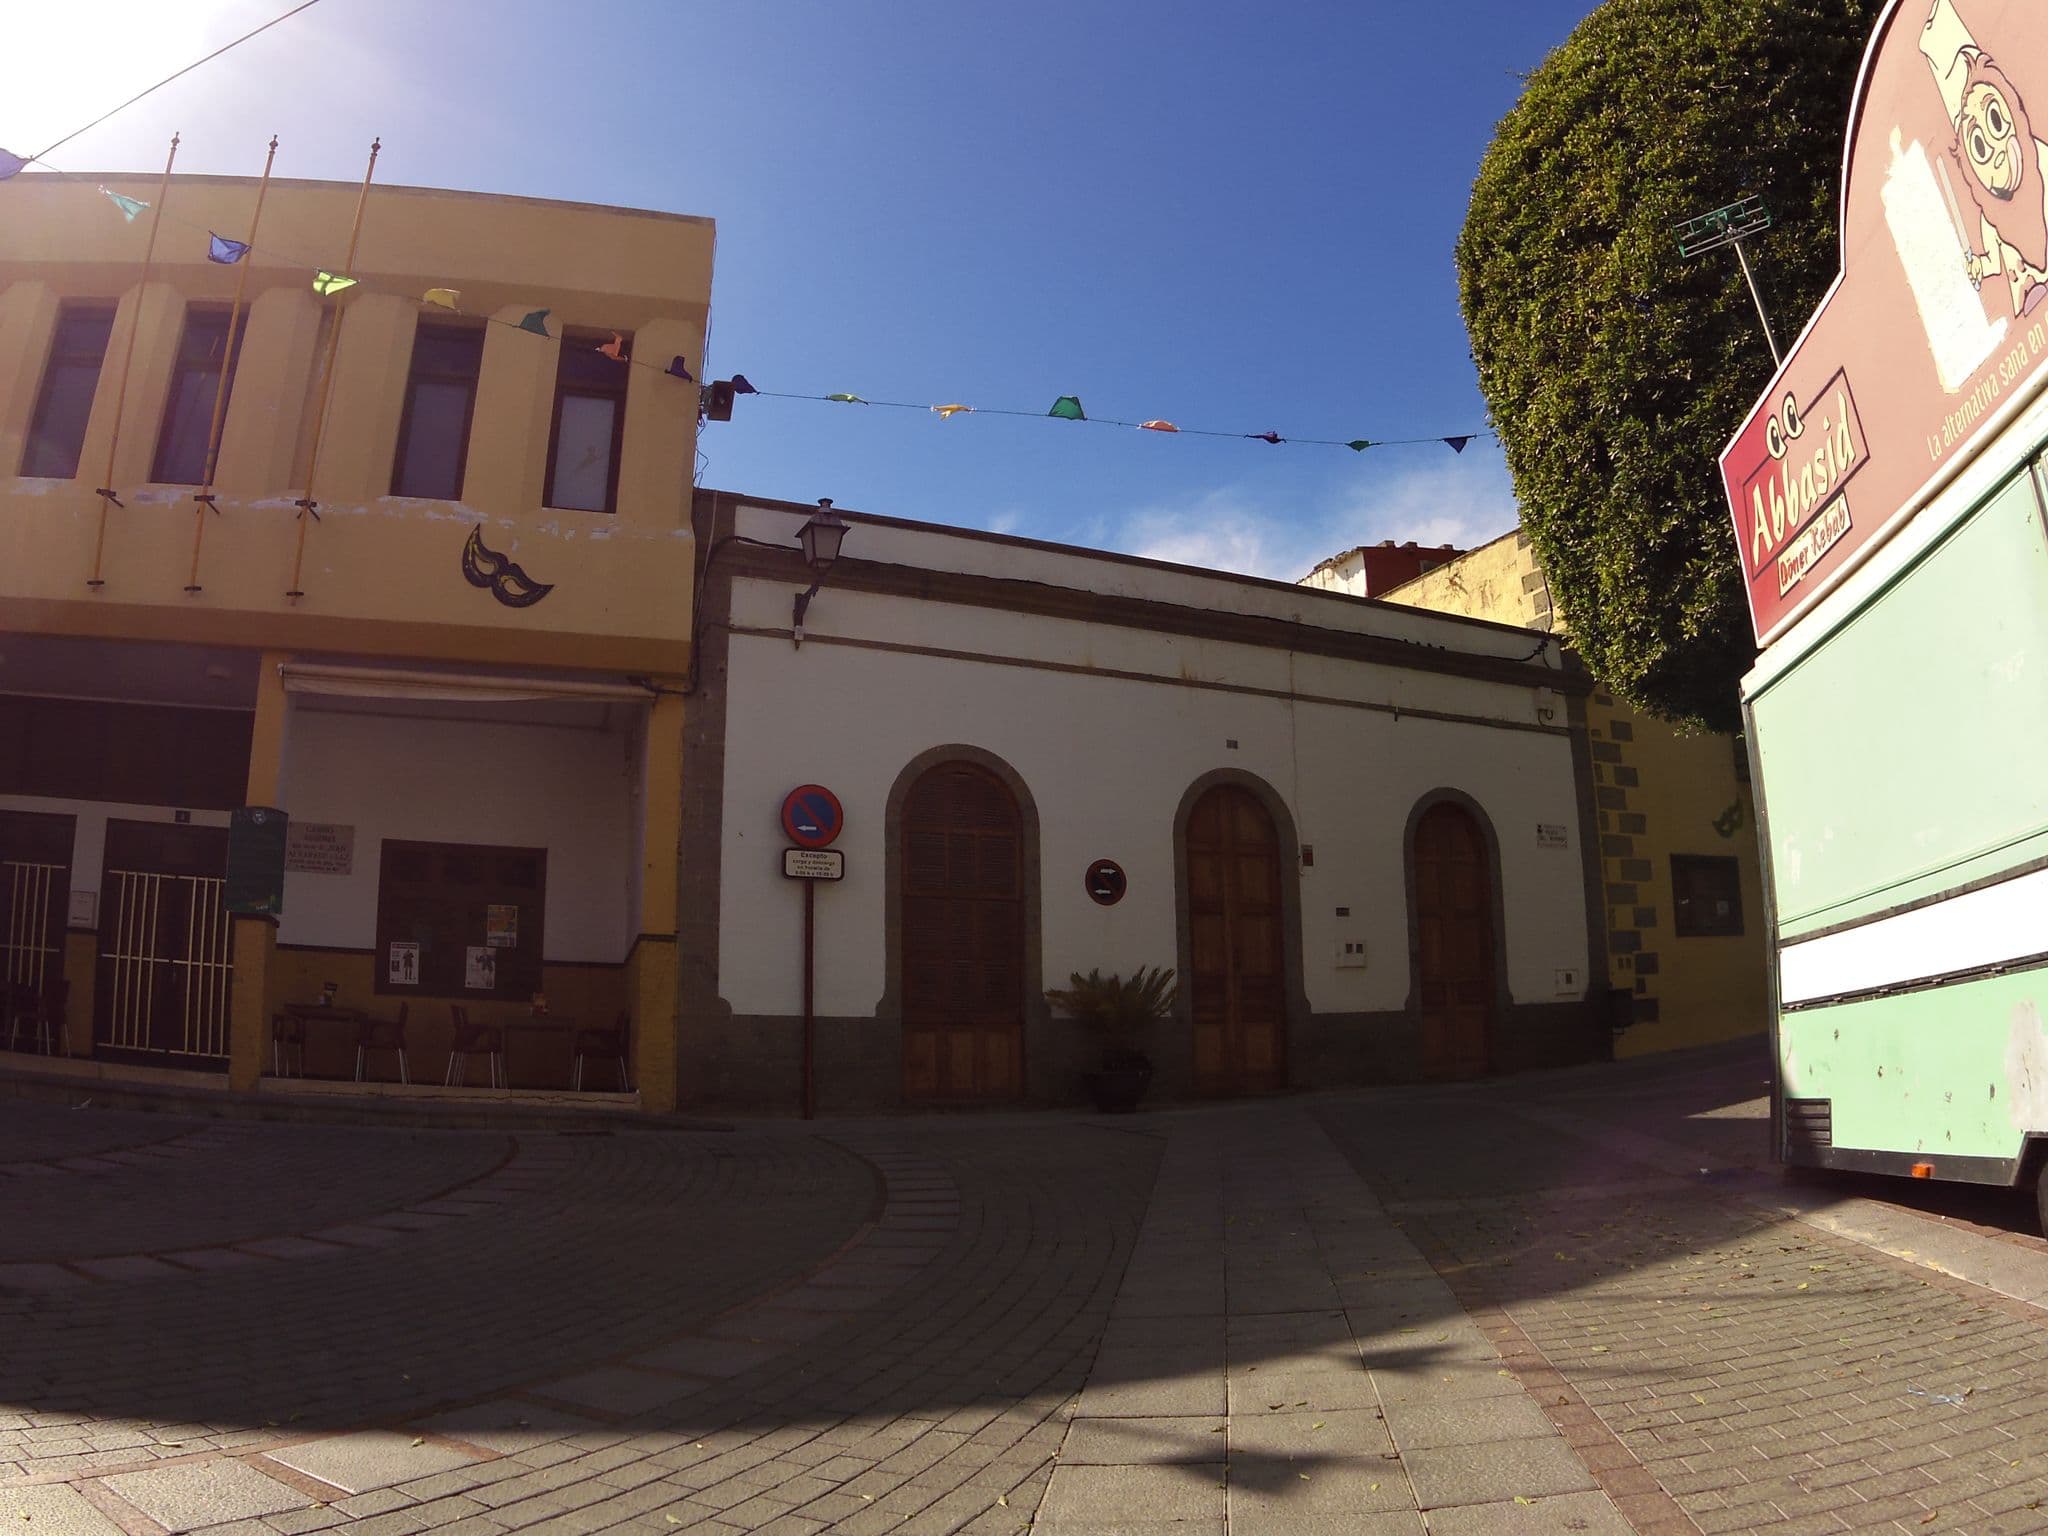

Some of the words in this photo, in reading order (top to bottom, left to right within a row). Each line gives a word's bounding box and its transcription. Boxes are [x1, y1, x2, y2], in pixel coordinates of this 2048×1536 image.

[1926, 434, 1942, 461] La
[1941, 373, 2000, 448] alternativa
[1999, 341, 2029, 387] sana
[2027, 322, 2047, 355] en
[1752, 390, 1856, 567] Abbasid
[1780, 546, 1809, 587] Döner
[1810, 501, 1846, 556] Kebab
